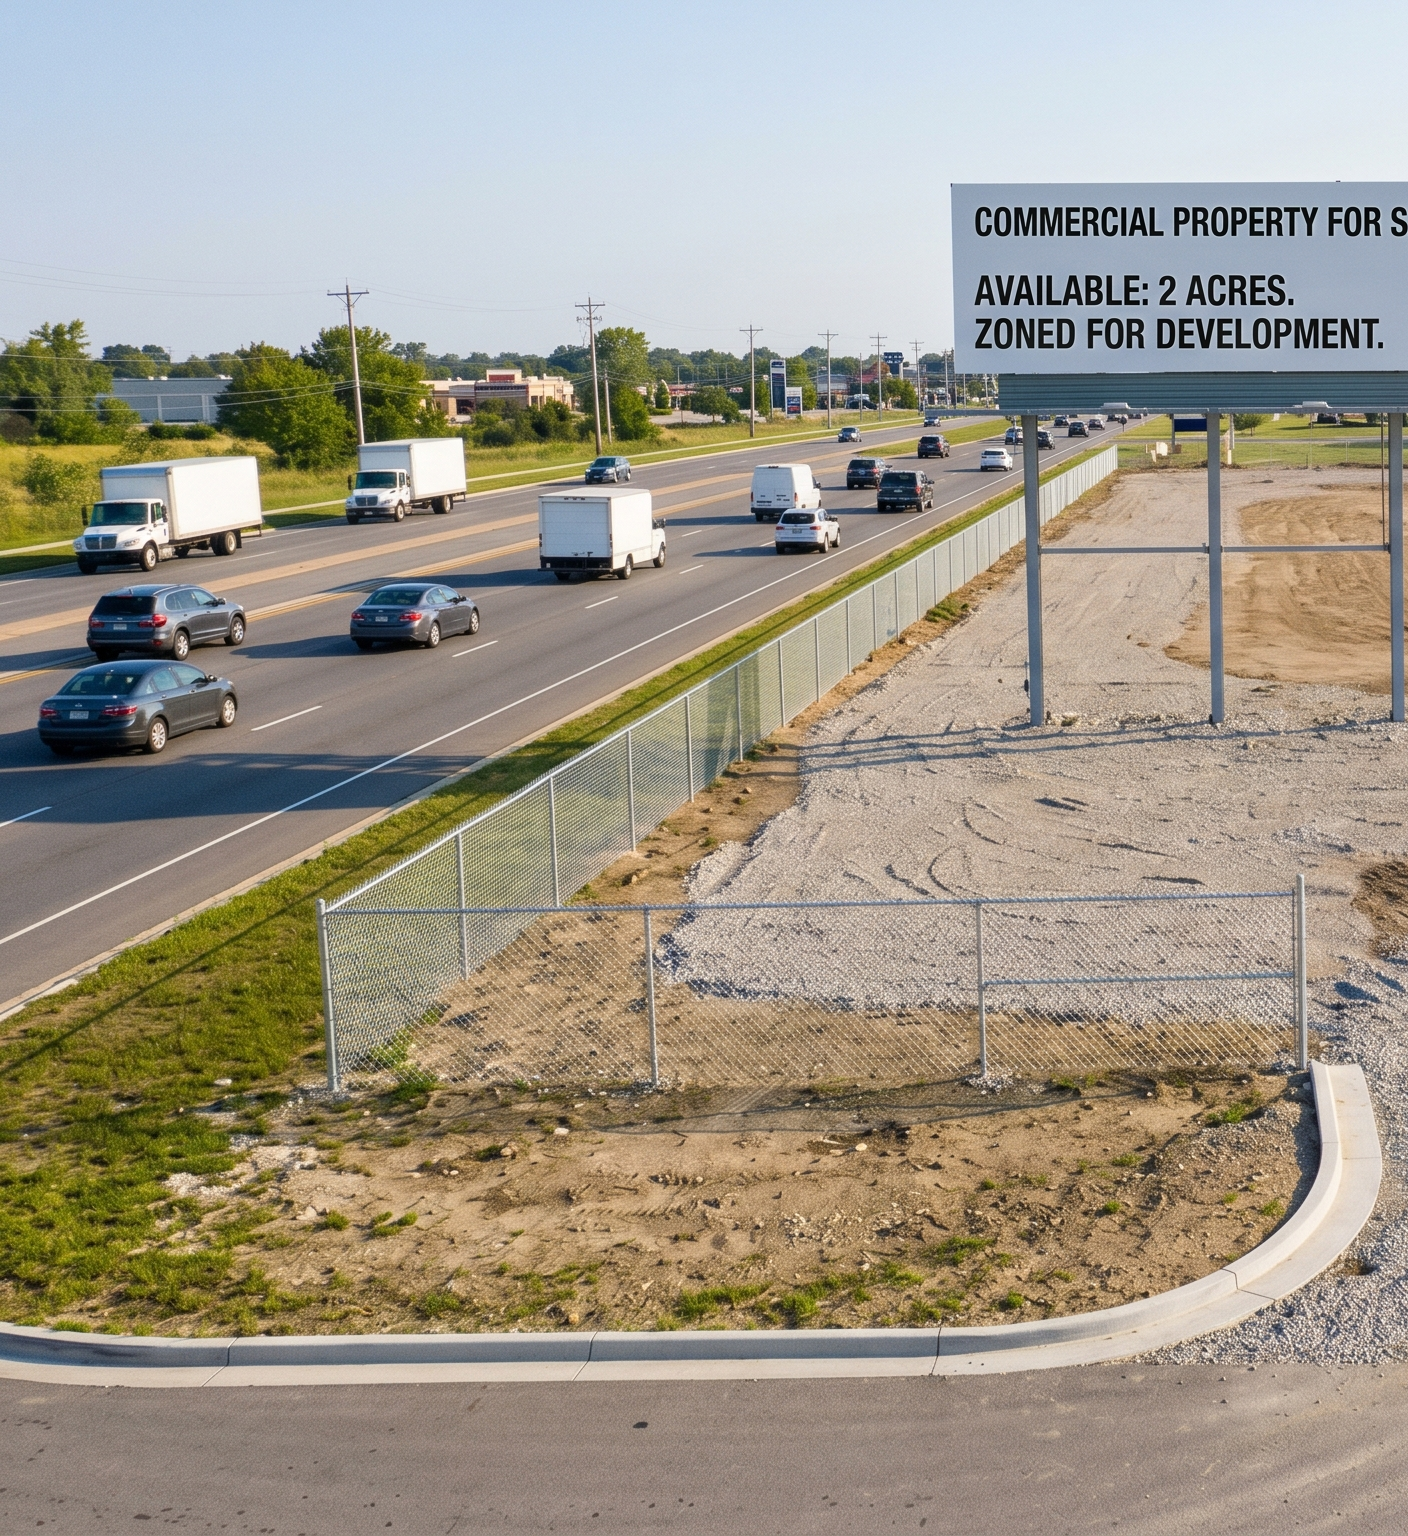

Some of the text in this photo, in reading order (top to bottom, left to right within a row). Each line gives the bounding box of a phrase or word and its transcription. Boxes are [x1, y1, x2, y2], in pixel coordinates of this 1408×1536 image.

[974, 206, 1165, 237] COMMERCIAL
[1173, 206, 1319, 237] PROPERTY
[1328, 206, 1382, 237] FOR
[974, 274, 1294, 307] AVAILABLE: 2 ACRES.
[974, 317, 1384, 350] ZONED FOR DEVELOPMENT.
